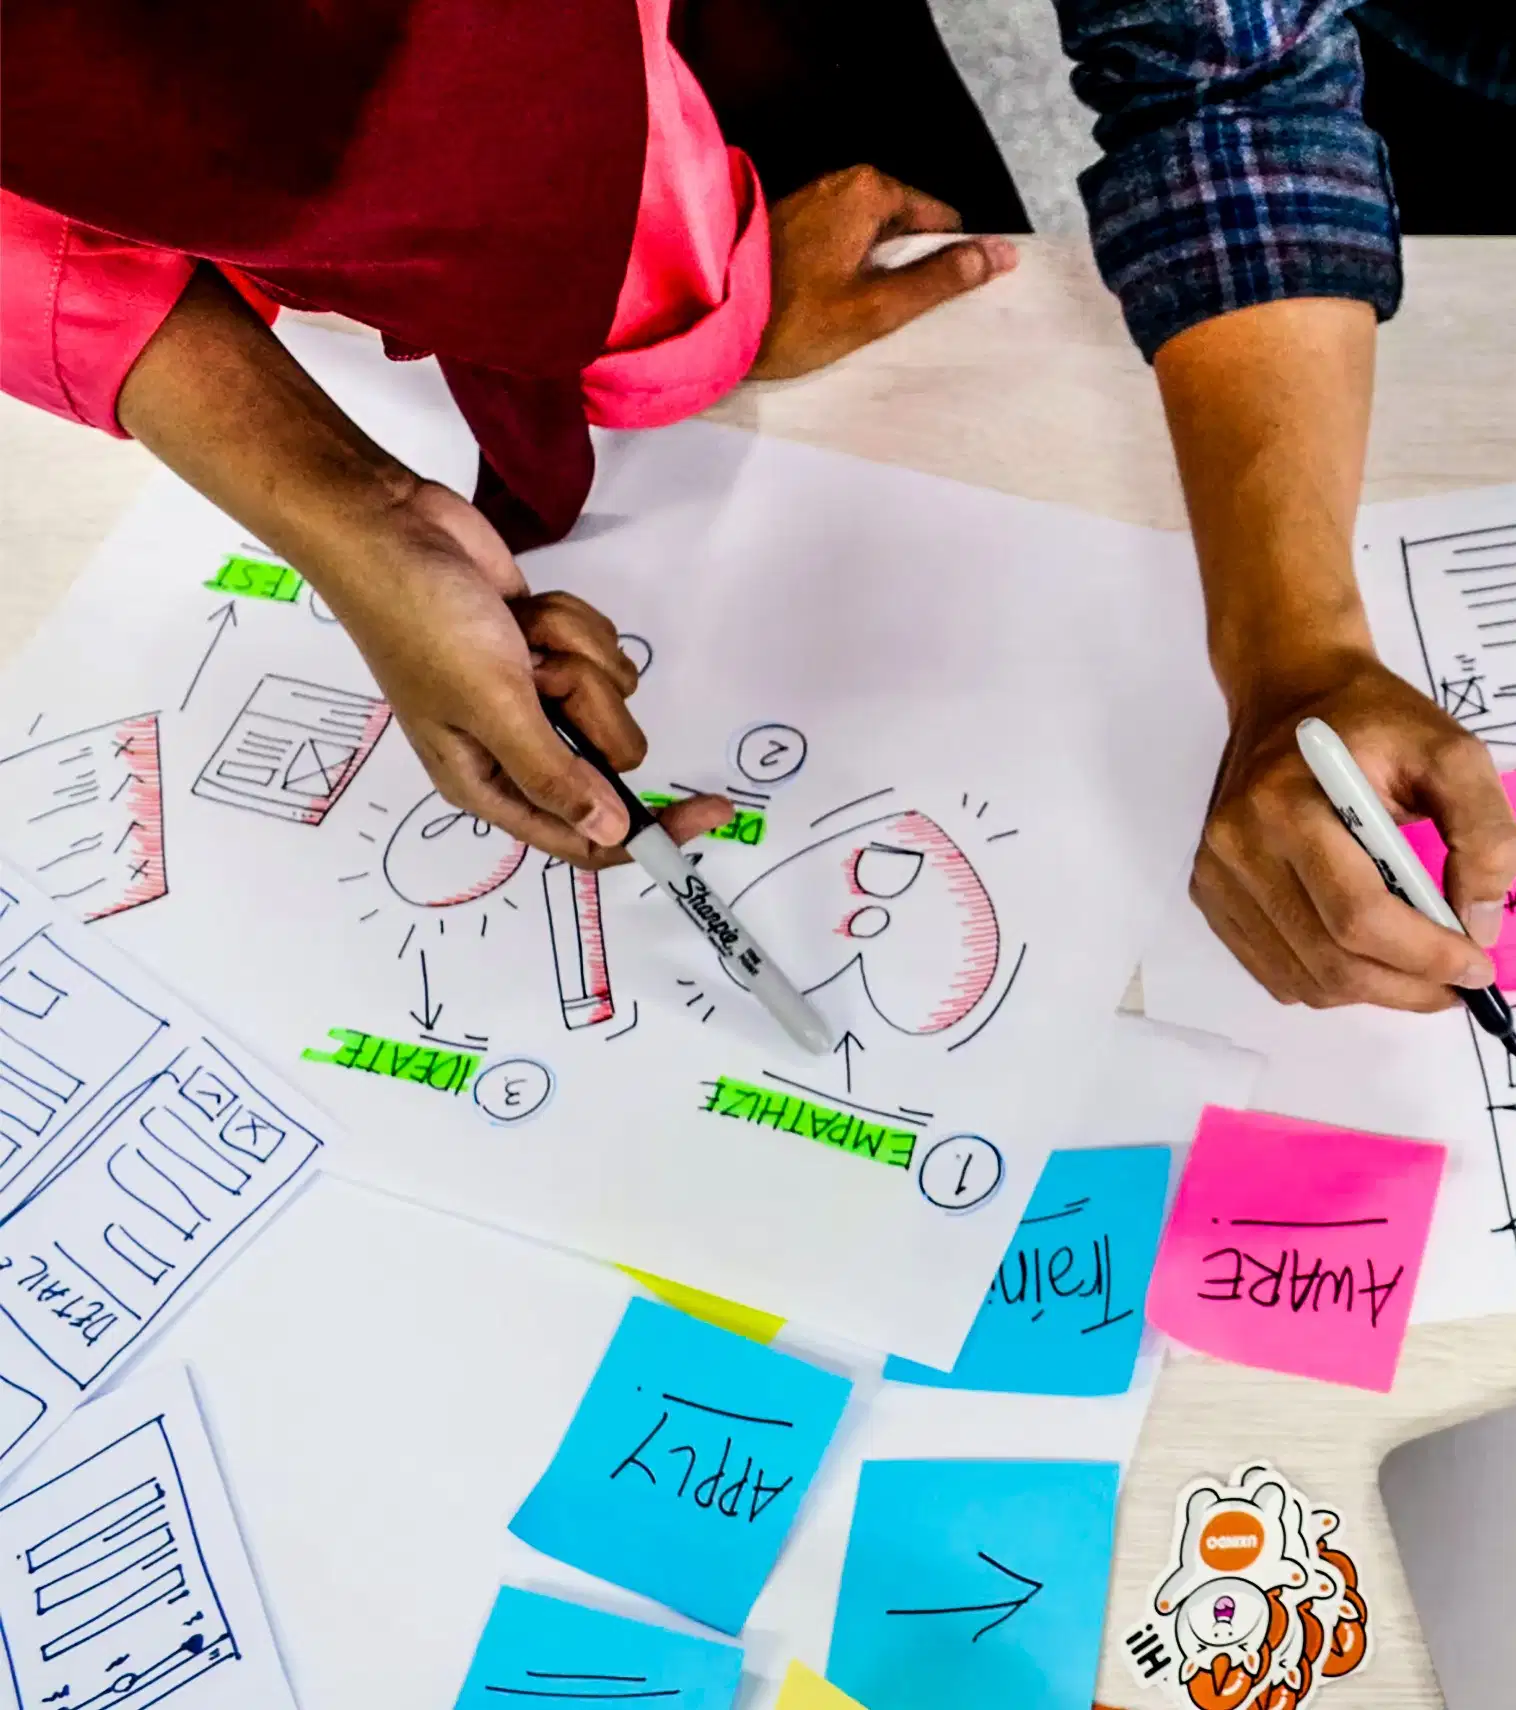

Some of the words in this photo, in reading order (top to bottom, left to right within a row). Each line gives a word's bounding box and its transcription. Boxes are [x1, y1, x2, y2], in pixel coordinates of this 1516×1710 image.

[759, 740, 789, 767] 2
[668, 874, 736, 950] Sharpie
[336, 1029, 472, 1096] IDEATE
[698, 1081, 918, 1171] EMPATHIZE
[17, 1255, 118, 1347] DETAIL
[988, 1234, 1133, 1334] Train
[1198, 1248, 1404, 1328] AWARE
[610, 1412, 793, 1523] APPLY
